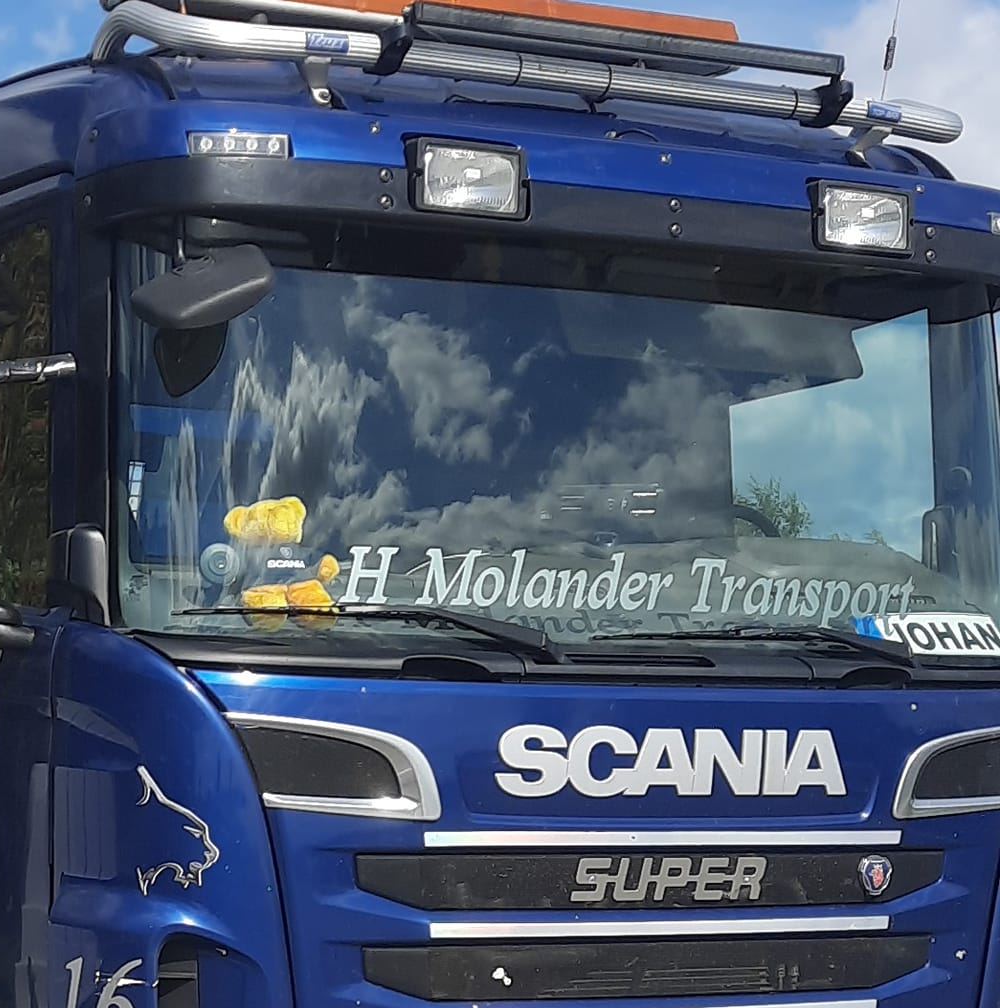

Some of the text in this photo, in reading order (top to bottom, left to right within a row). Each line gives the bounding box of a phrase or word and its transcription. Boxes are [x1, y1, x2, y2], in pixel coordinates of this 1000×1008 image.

[266, 559, 306, 569] SCANIA
[338, 546, 399, 605] H
[413, 548, 674, 611] Molander
[690, 557, 915, 635] Transport
[494, 724, 847, 798] SCANIA
[570, 856, 768, 902] SUPER
